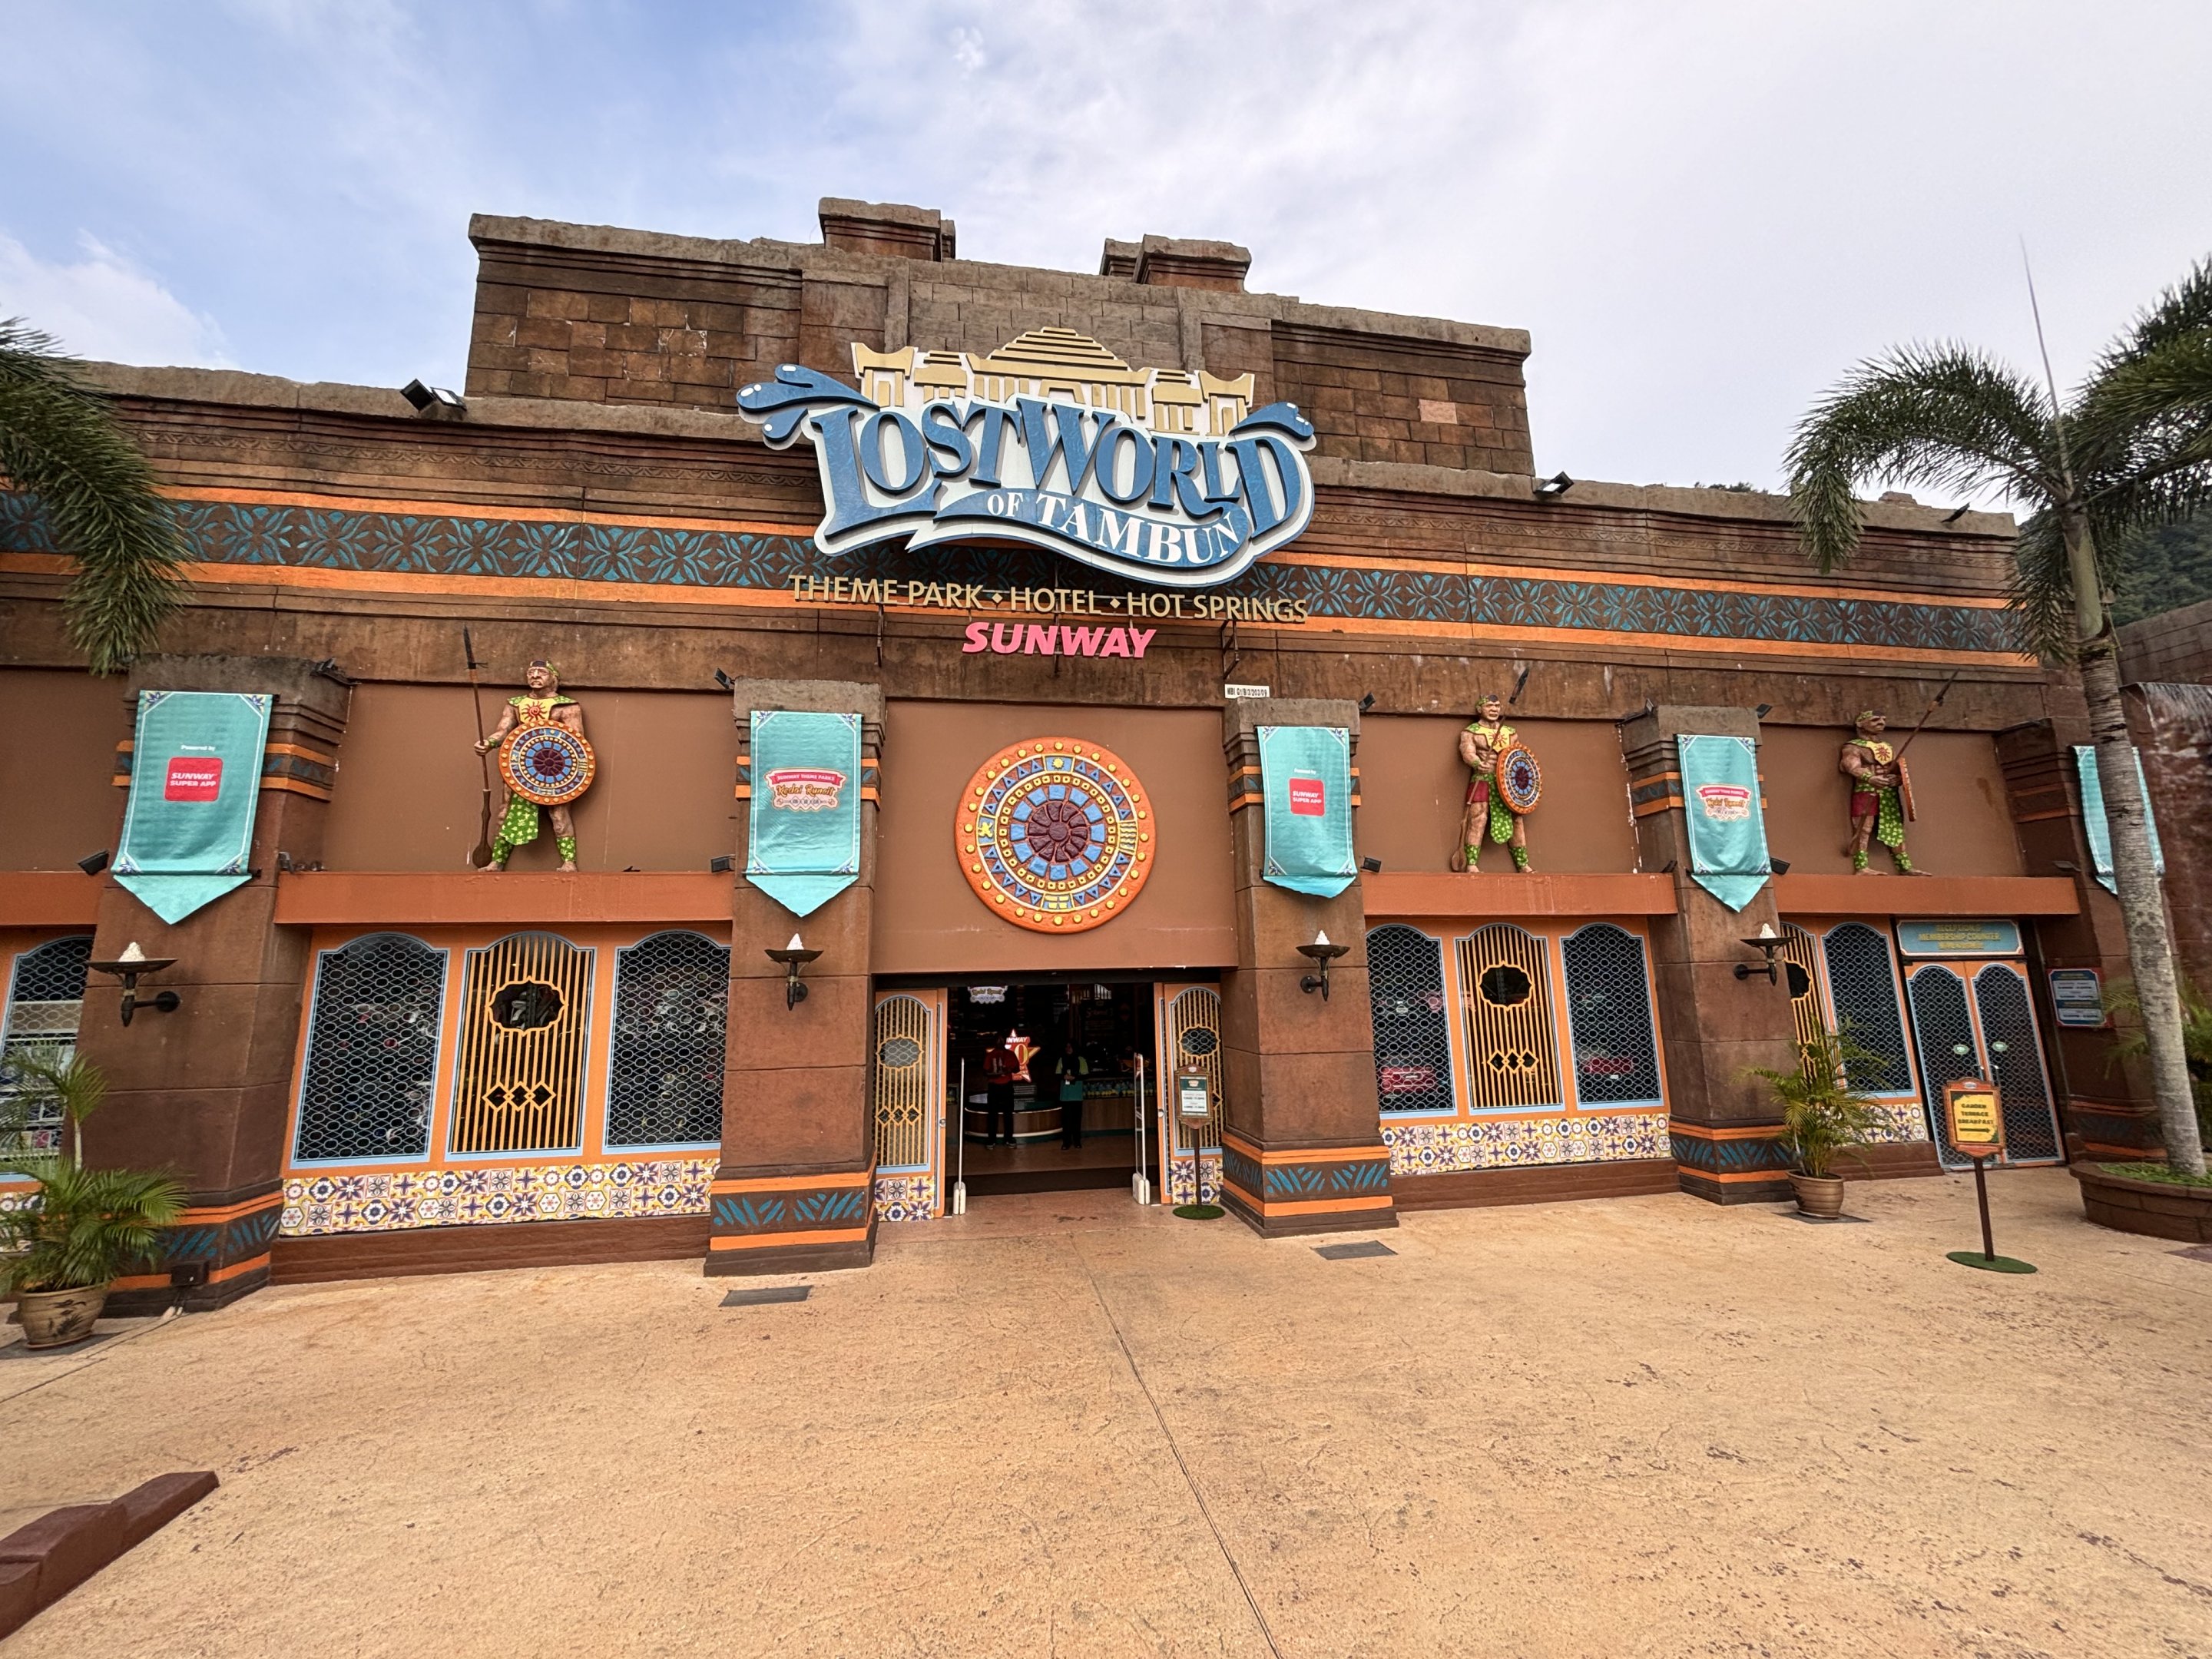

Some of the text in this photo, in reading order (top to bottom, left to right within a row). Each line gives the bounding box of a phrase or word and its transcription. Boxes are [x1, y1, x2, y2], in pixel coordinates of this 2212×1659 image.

[986, 492, 1240, 565] OF TAMBUN
[788, 575, 1307, 623] THEME PARK HOTEL HOT SPRINGS
[962, 621, 1157, 658] SUNWAY
